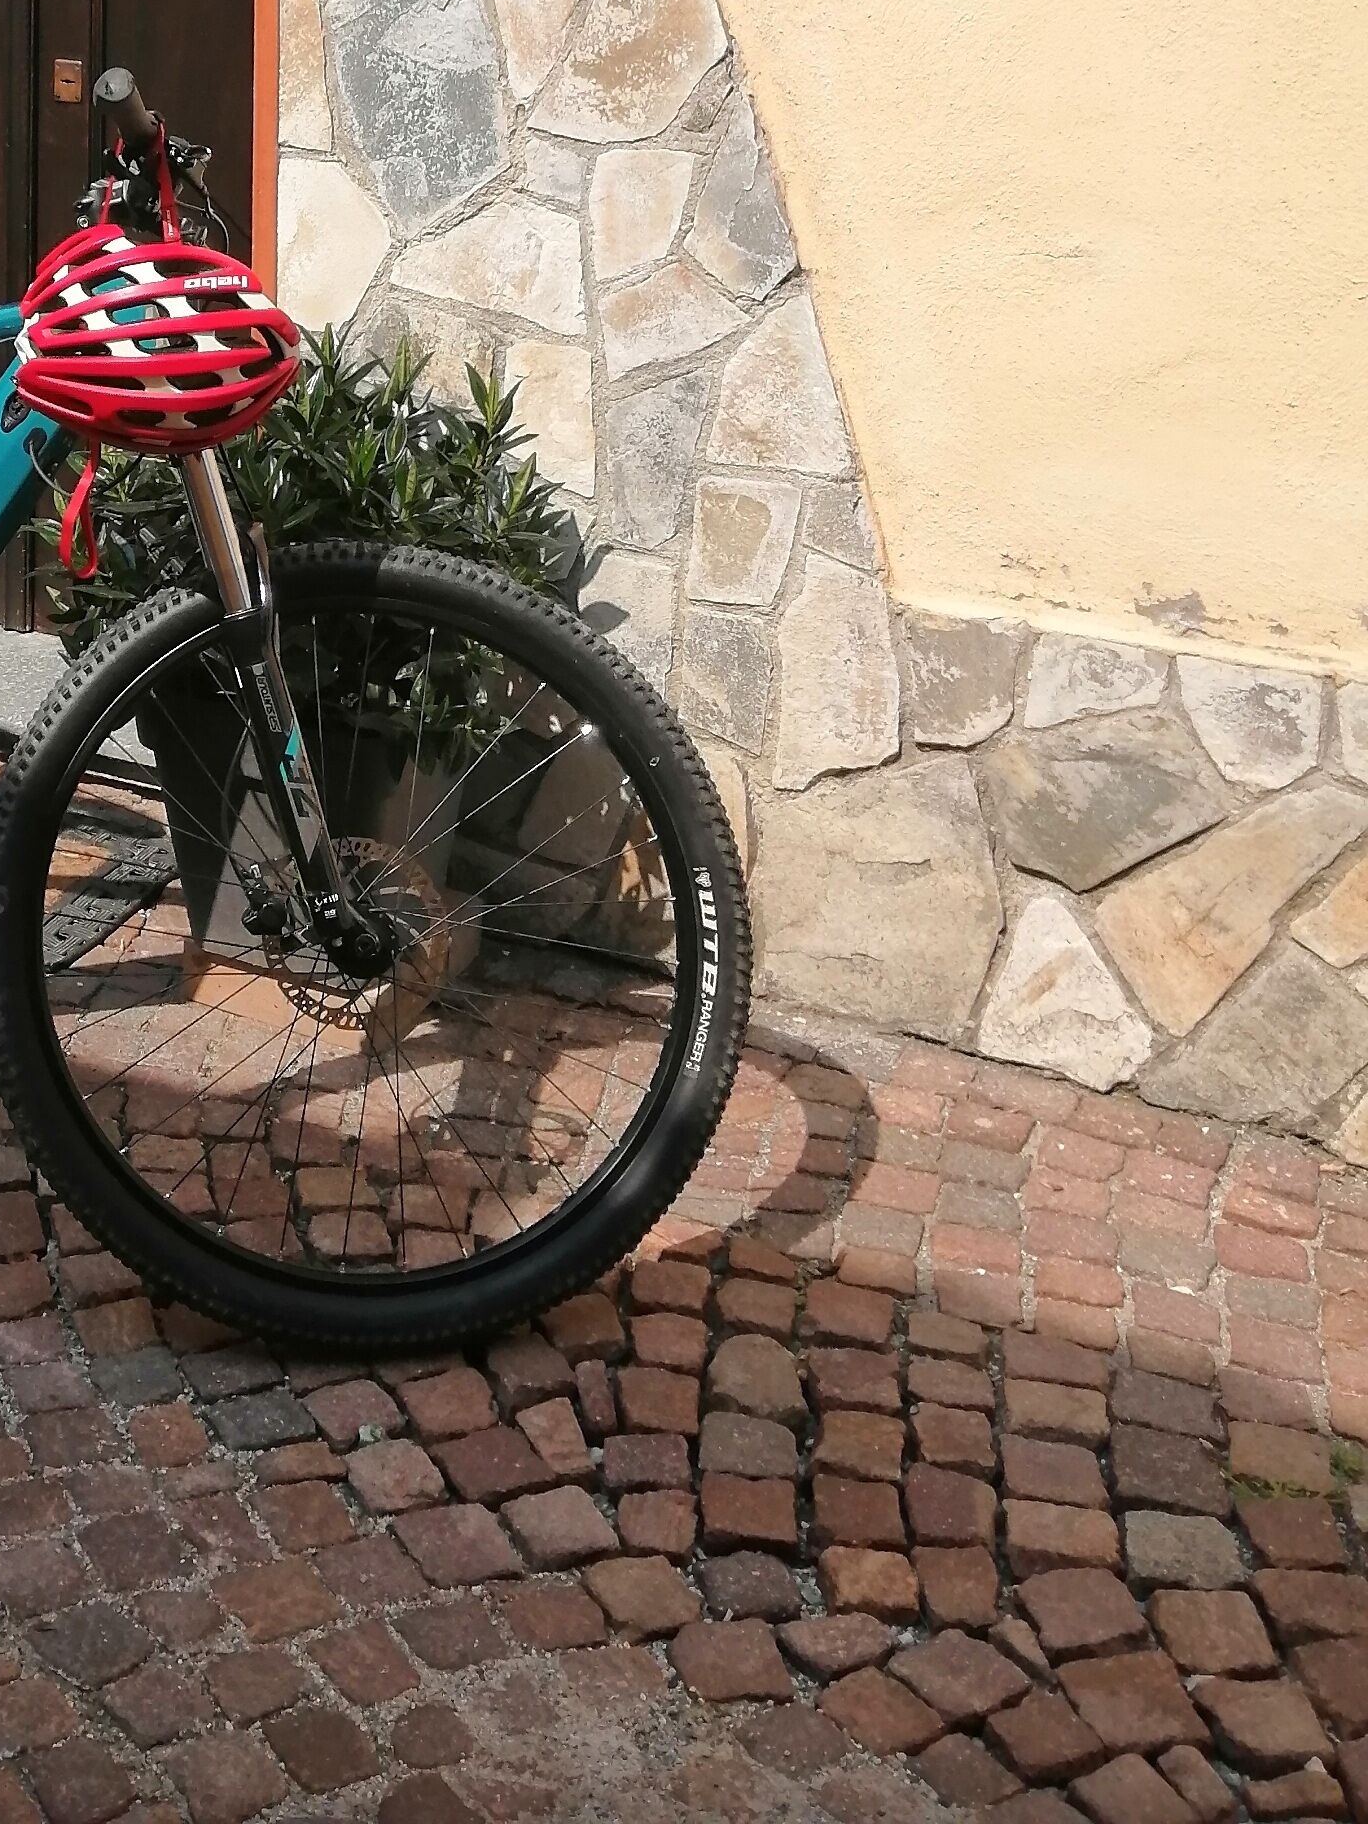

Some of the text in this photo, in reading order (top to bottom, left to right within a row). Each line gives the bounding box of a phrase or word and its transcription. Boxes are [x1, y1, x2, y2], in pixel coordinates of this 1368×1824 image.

[183, 275, 248, 289] hebo
[697, 889, 719, 996] WTB
[691, 998, 714, 1064] RANGER
